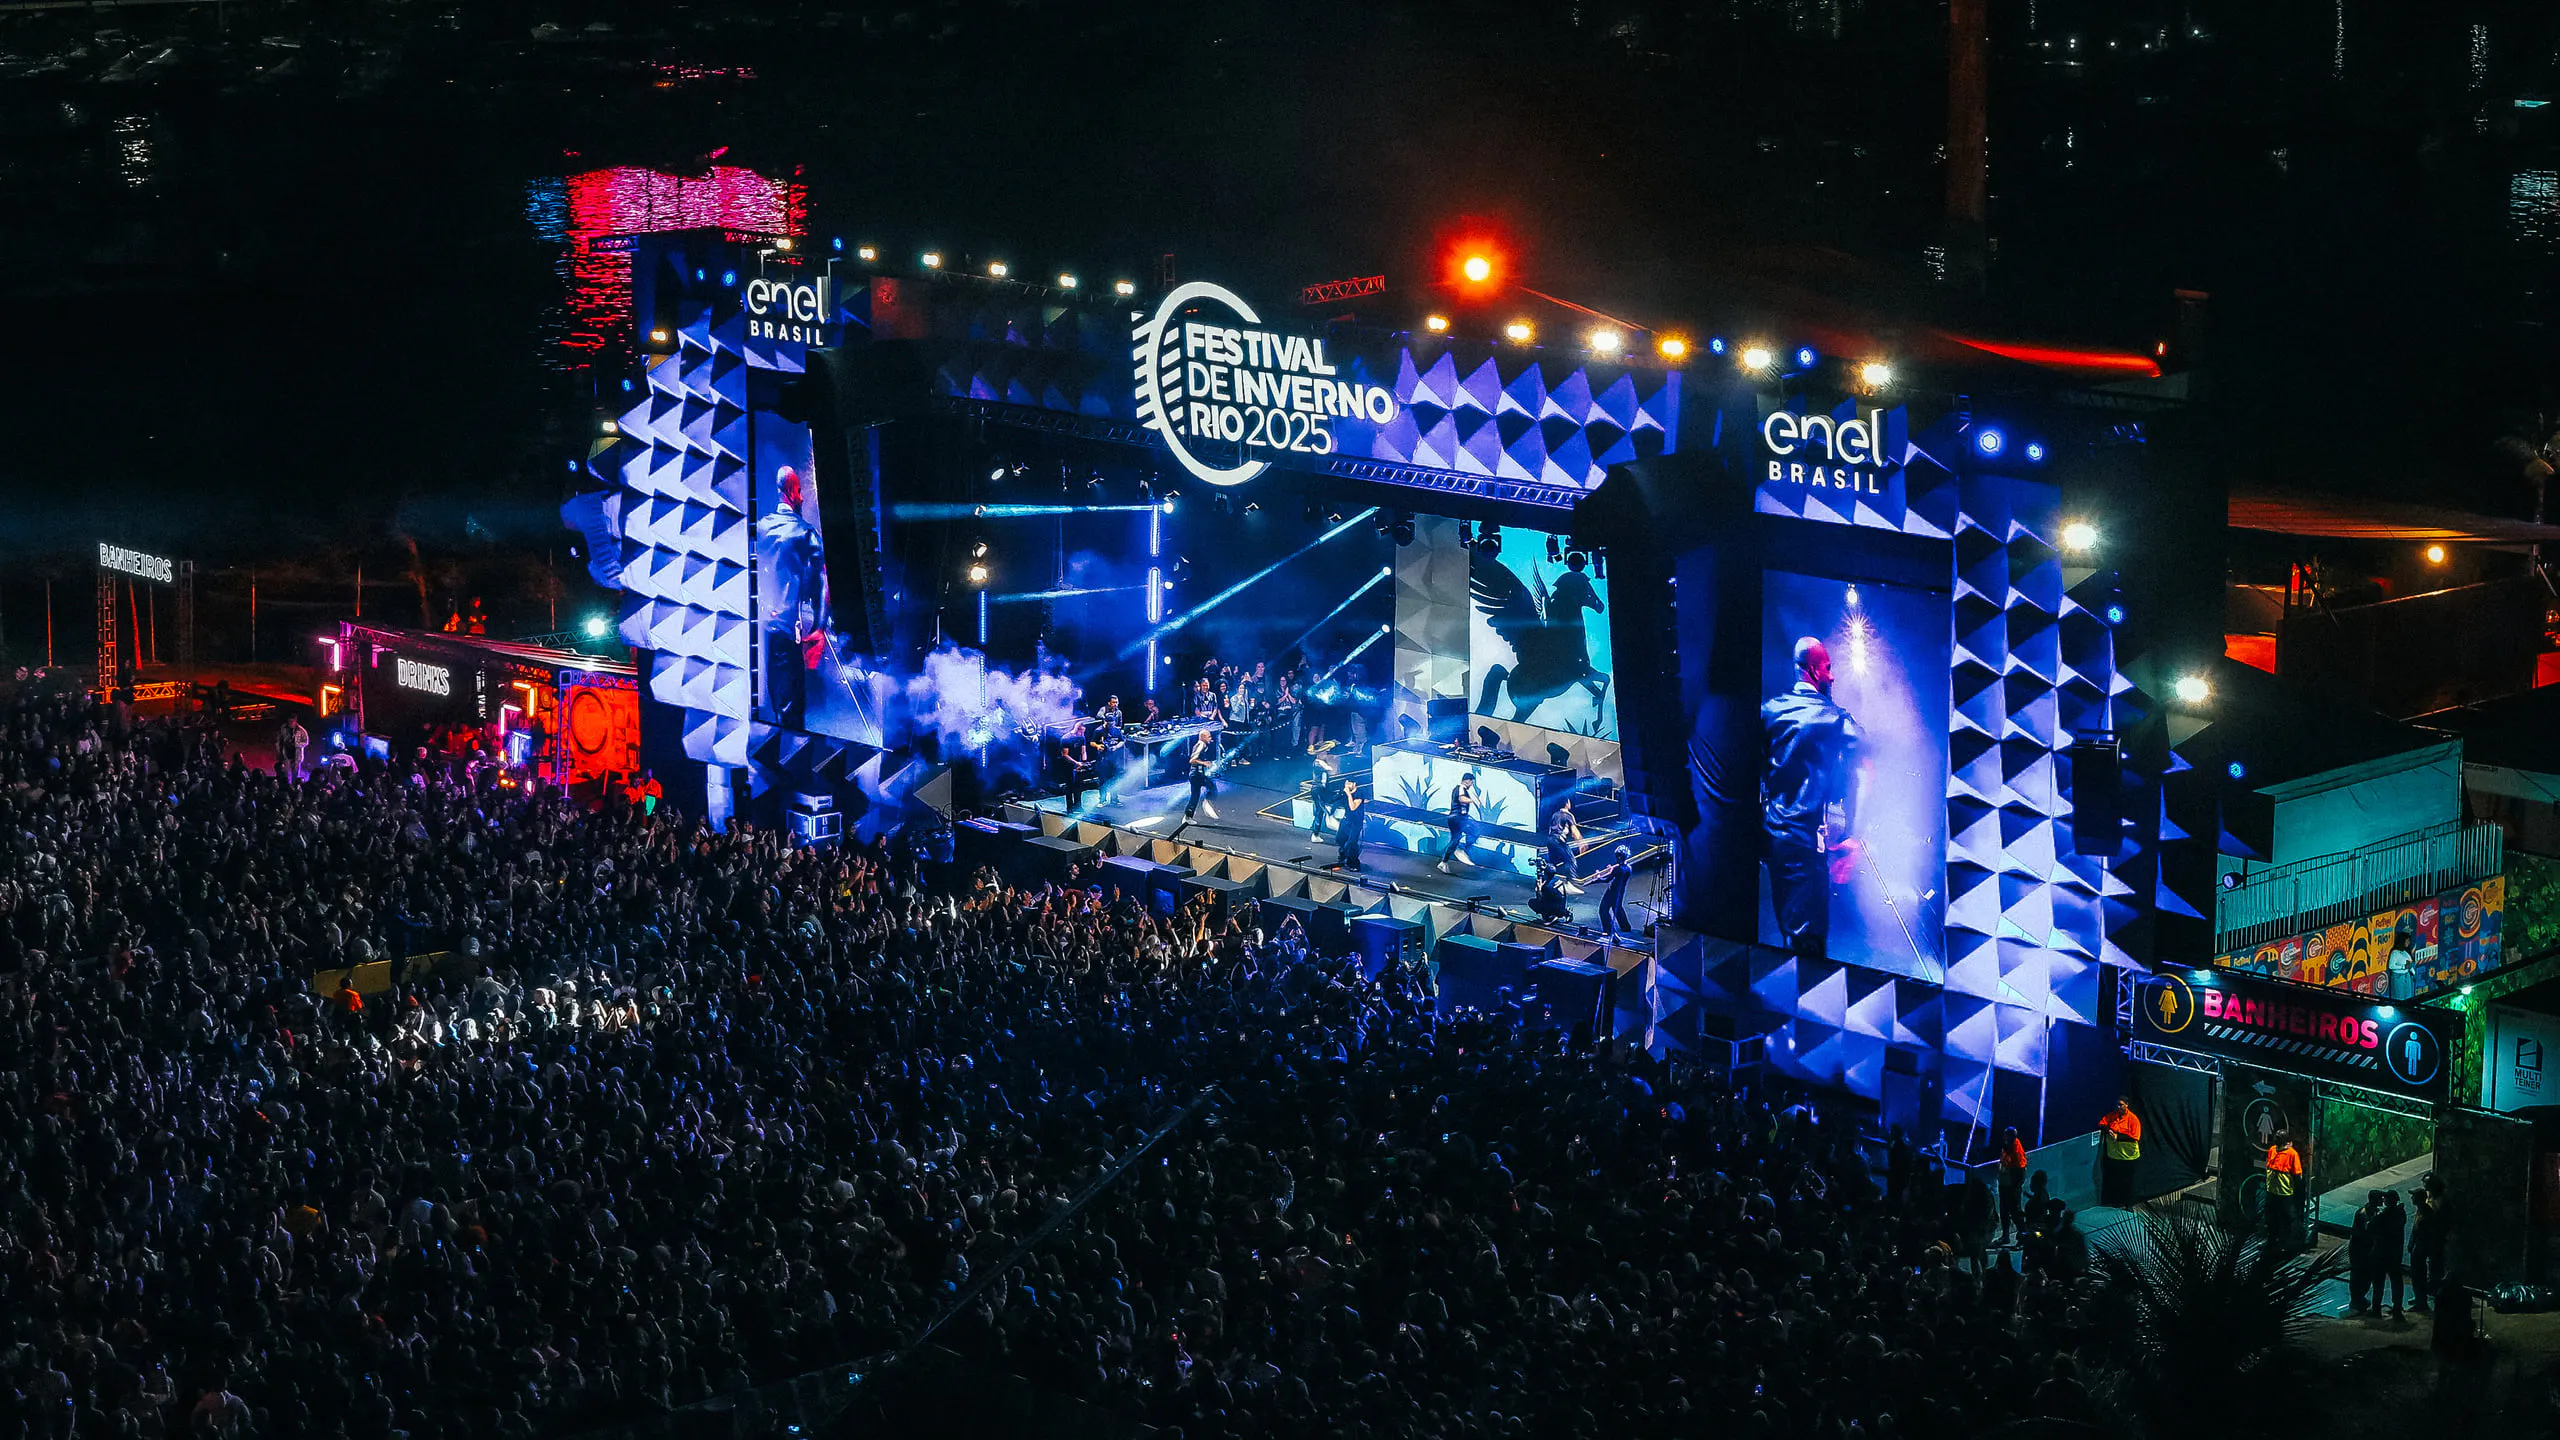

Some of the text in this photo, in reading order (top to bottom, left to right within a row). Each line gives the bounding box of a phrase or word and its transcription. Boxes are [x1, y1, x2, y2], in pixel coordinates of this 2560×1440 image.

[747, 277, 825, 324] enel
[750, 320, 823, 346] BRASIL
[1185, 322, 1336, 376] FESTIVAL
[1187, 361, 1395, 425] DE INVERNO
[1764, 408, 1883, 467] enel
[1768, 460, 1880, 494] BRASIL
[99, 542, 173, 582] BANHEIROS
[397, 658, 450, 696] DRINKS
[2204, 987, 2379, 1049] BANHEIROS
[2514, 1068, 2542, 1082] MULTI
[2515, 1077, 2541, 1090] TEINER
